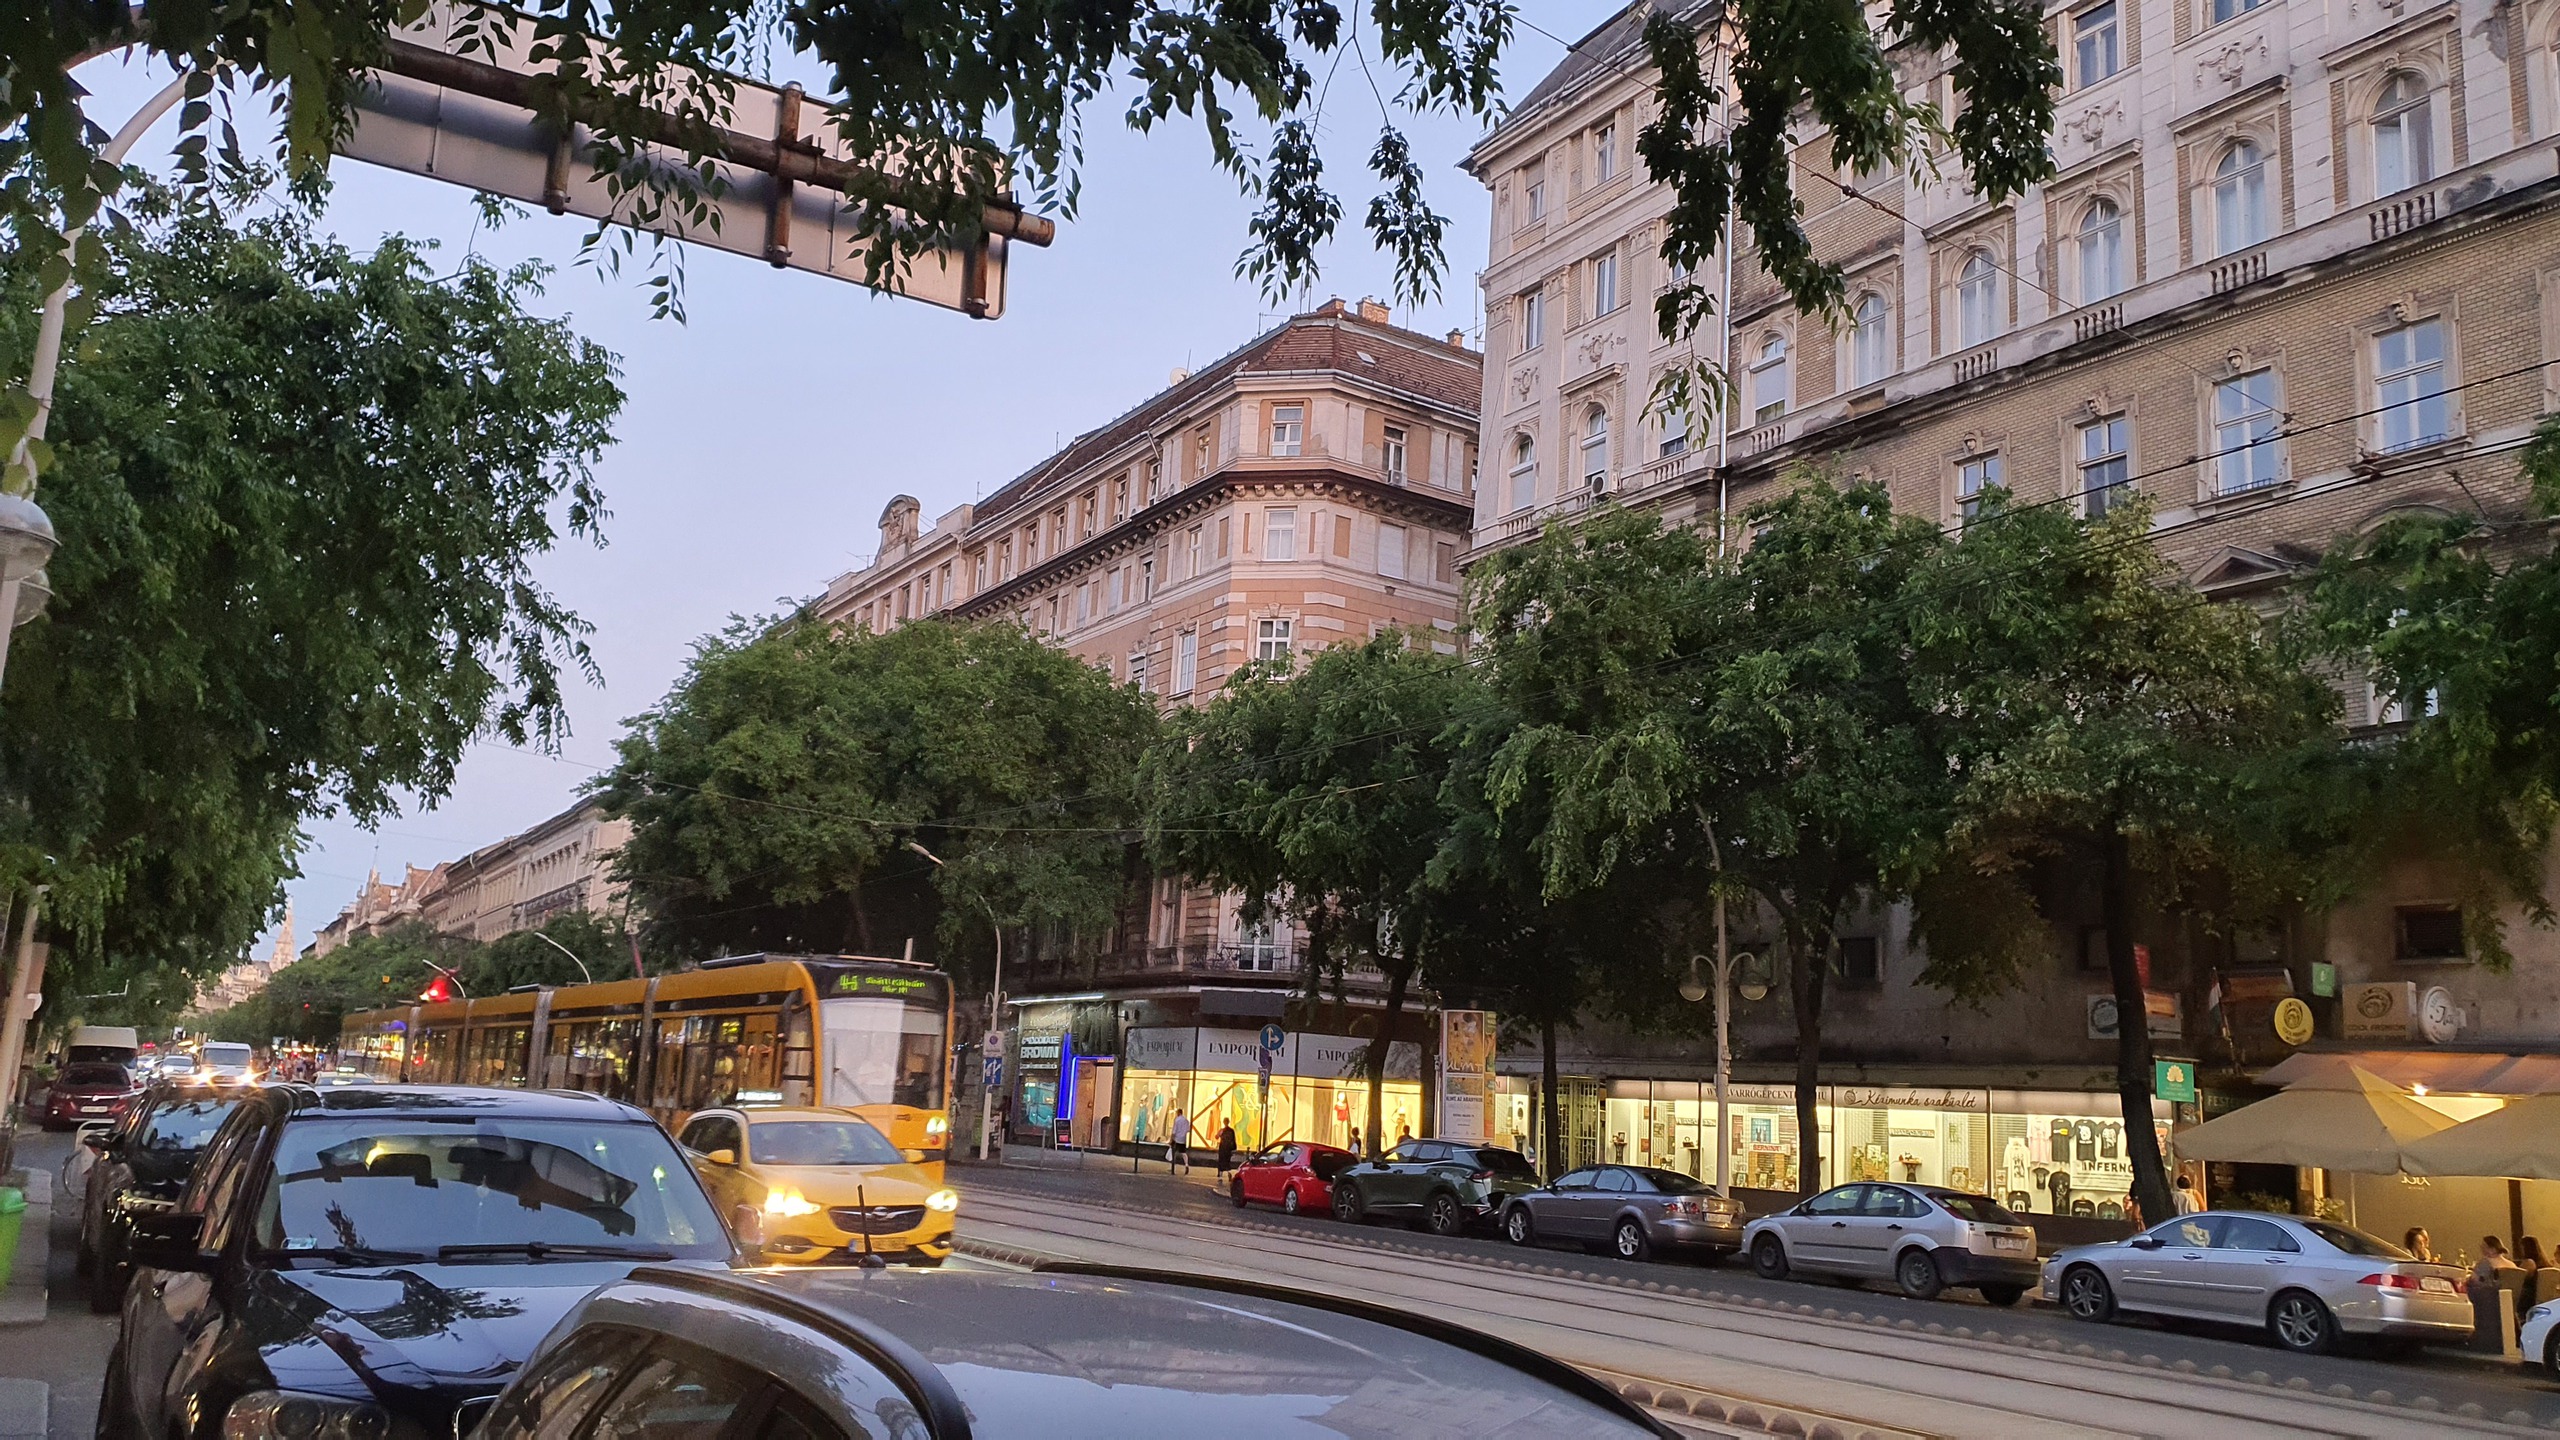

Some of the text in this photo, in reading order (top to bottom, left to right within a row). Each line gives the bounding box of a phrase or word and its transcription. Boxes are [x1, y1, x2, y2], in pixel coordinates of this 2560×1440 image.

[1020, 1045, 1059, 1059] BROWN
[1208, 1042, 1286, 1062] EMPORM
[1861, 1088, 1977, 1109] Kézimunka szaküzlet
